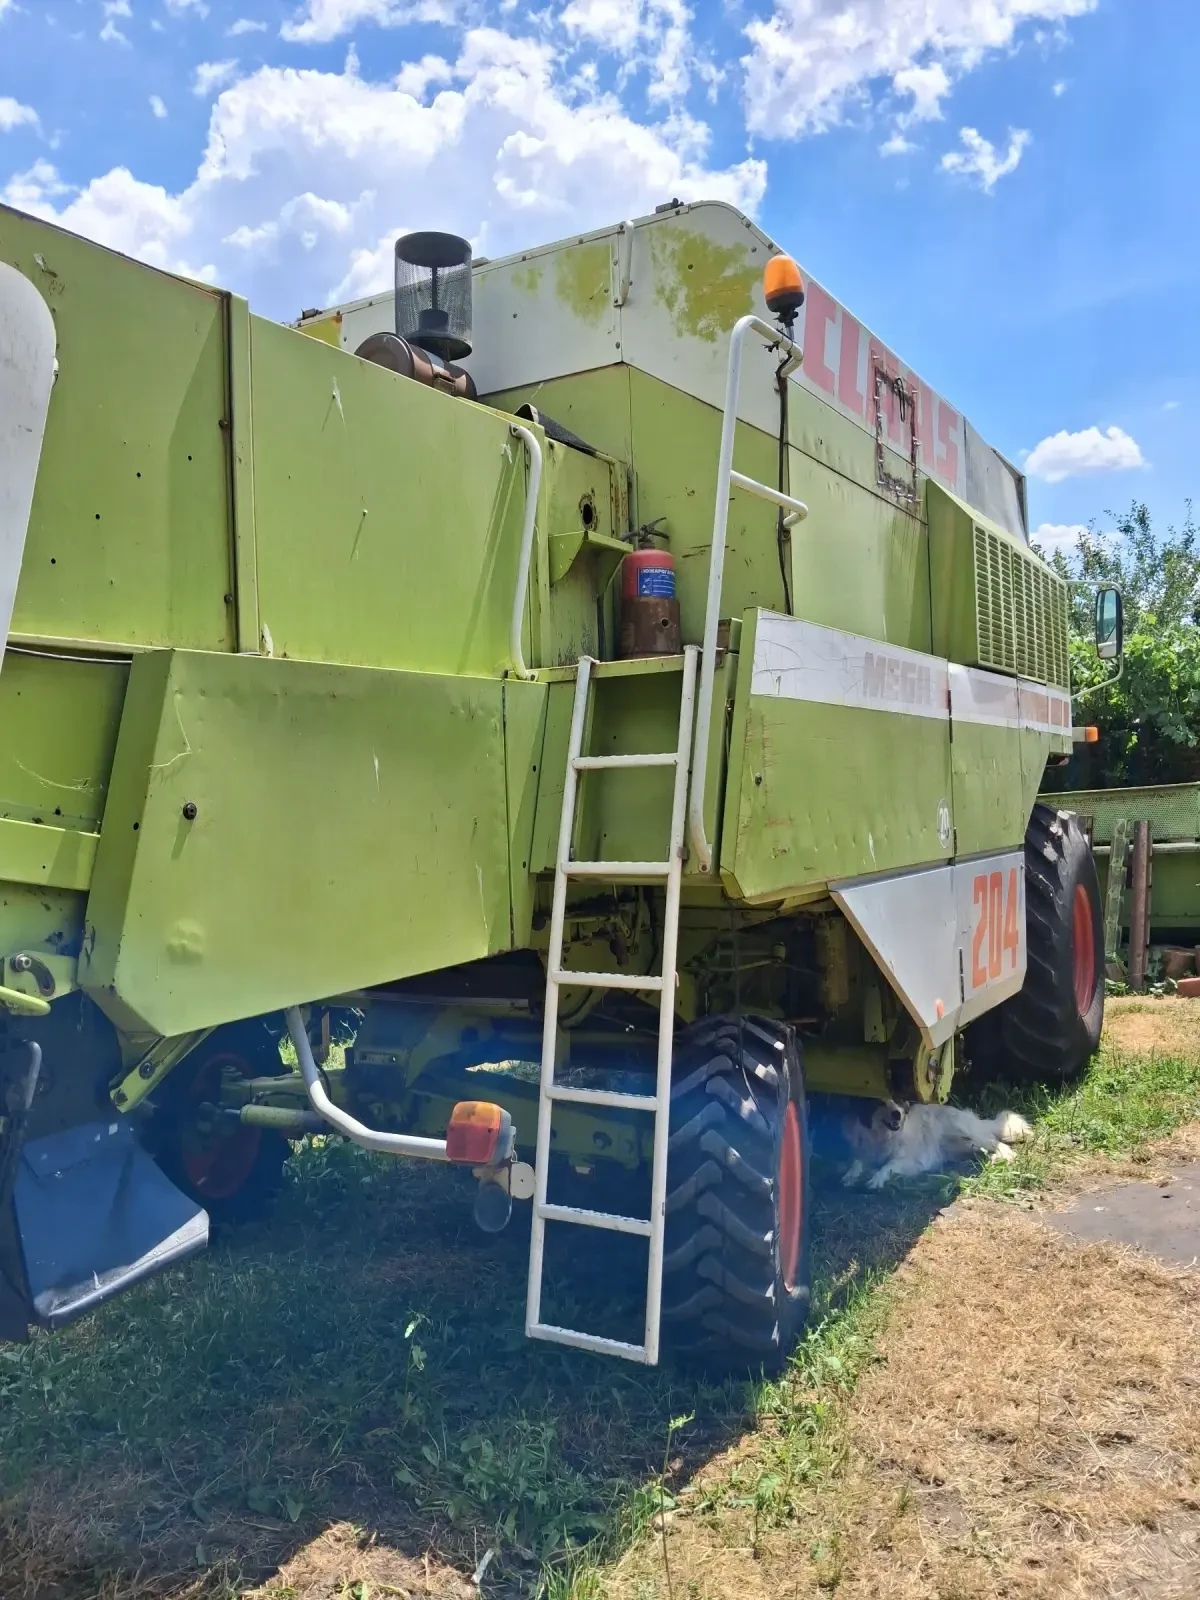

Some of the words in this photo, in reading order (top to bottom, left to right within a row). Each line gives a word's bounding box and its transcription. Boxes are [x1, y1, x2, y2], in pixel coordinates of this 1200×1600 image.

[803, 282, 959, 486] CLAAS
[863, 652, 931, 705] MEGA
[972, 867, 1019, 989] 204
